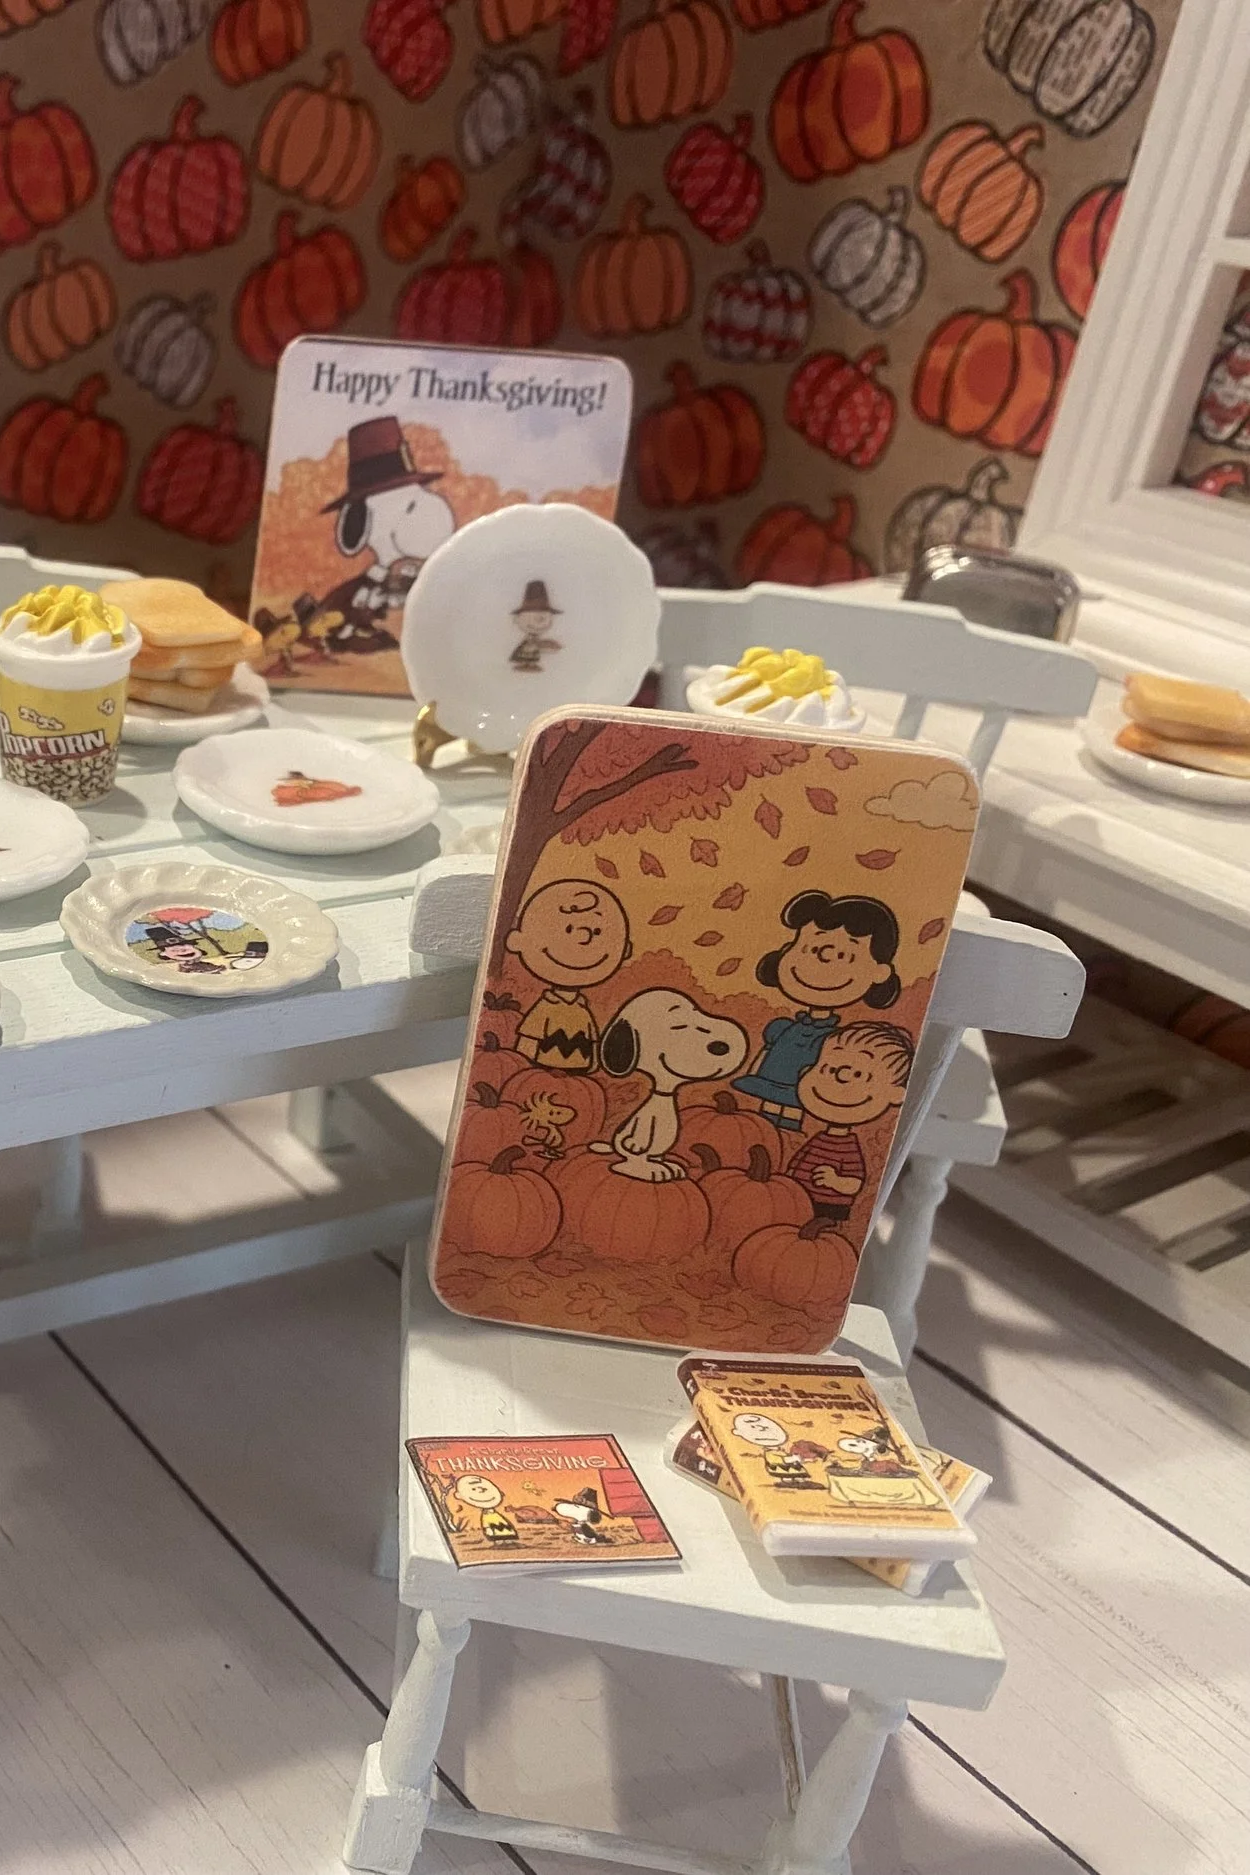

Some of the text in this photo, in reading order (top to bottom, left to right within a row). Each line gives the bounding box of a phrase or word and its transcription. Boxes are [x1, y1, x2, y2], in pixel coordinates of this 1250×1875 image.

[311, 361, 608, 416] Happy Thanksgiving!
[727, 1386, 852, 1401] Charlie Brown
[720, 1395, 870, 1412] THANKSGIVING
[435, 1454, 608, 1473] THANKSGIVING
